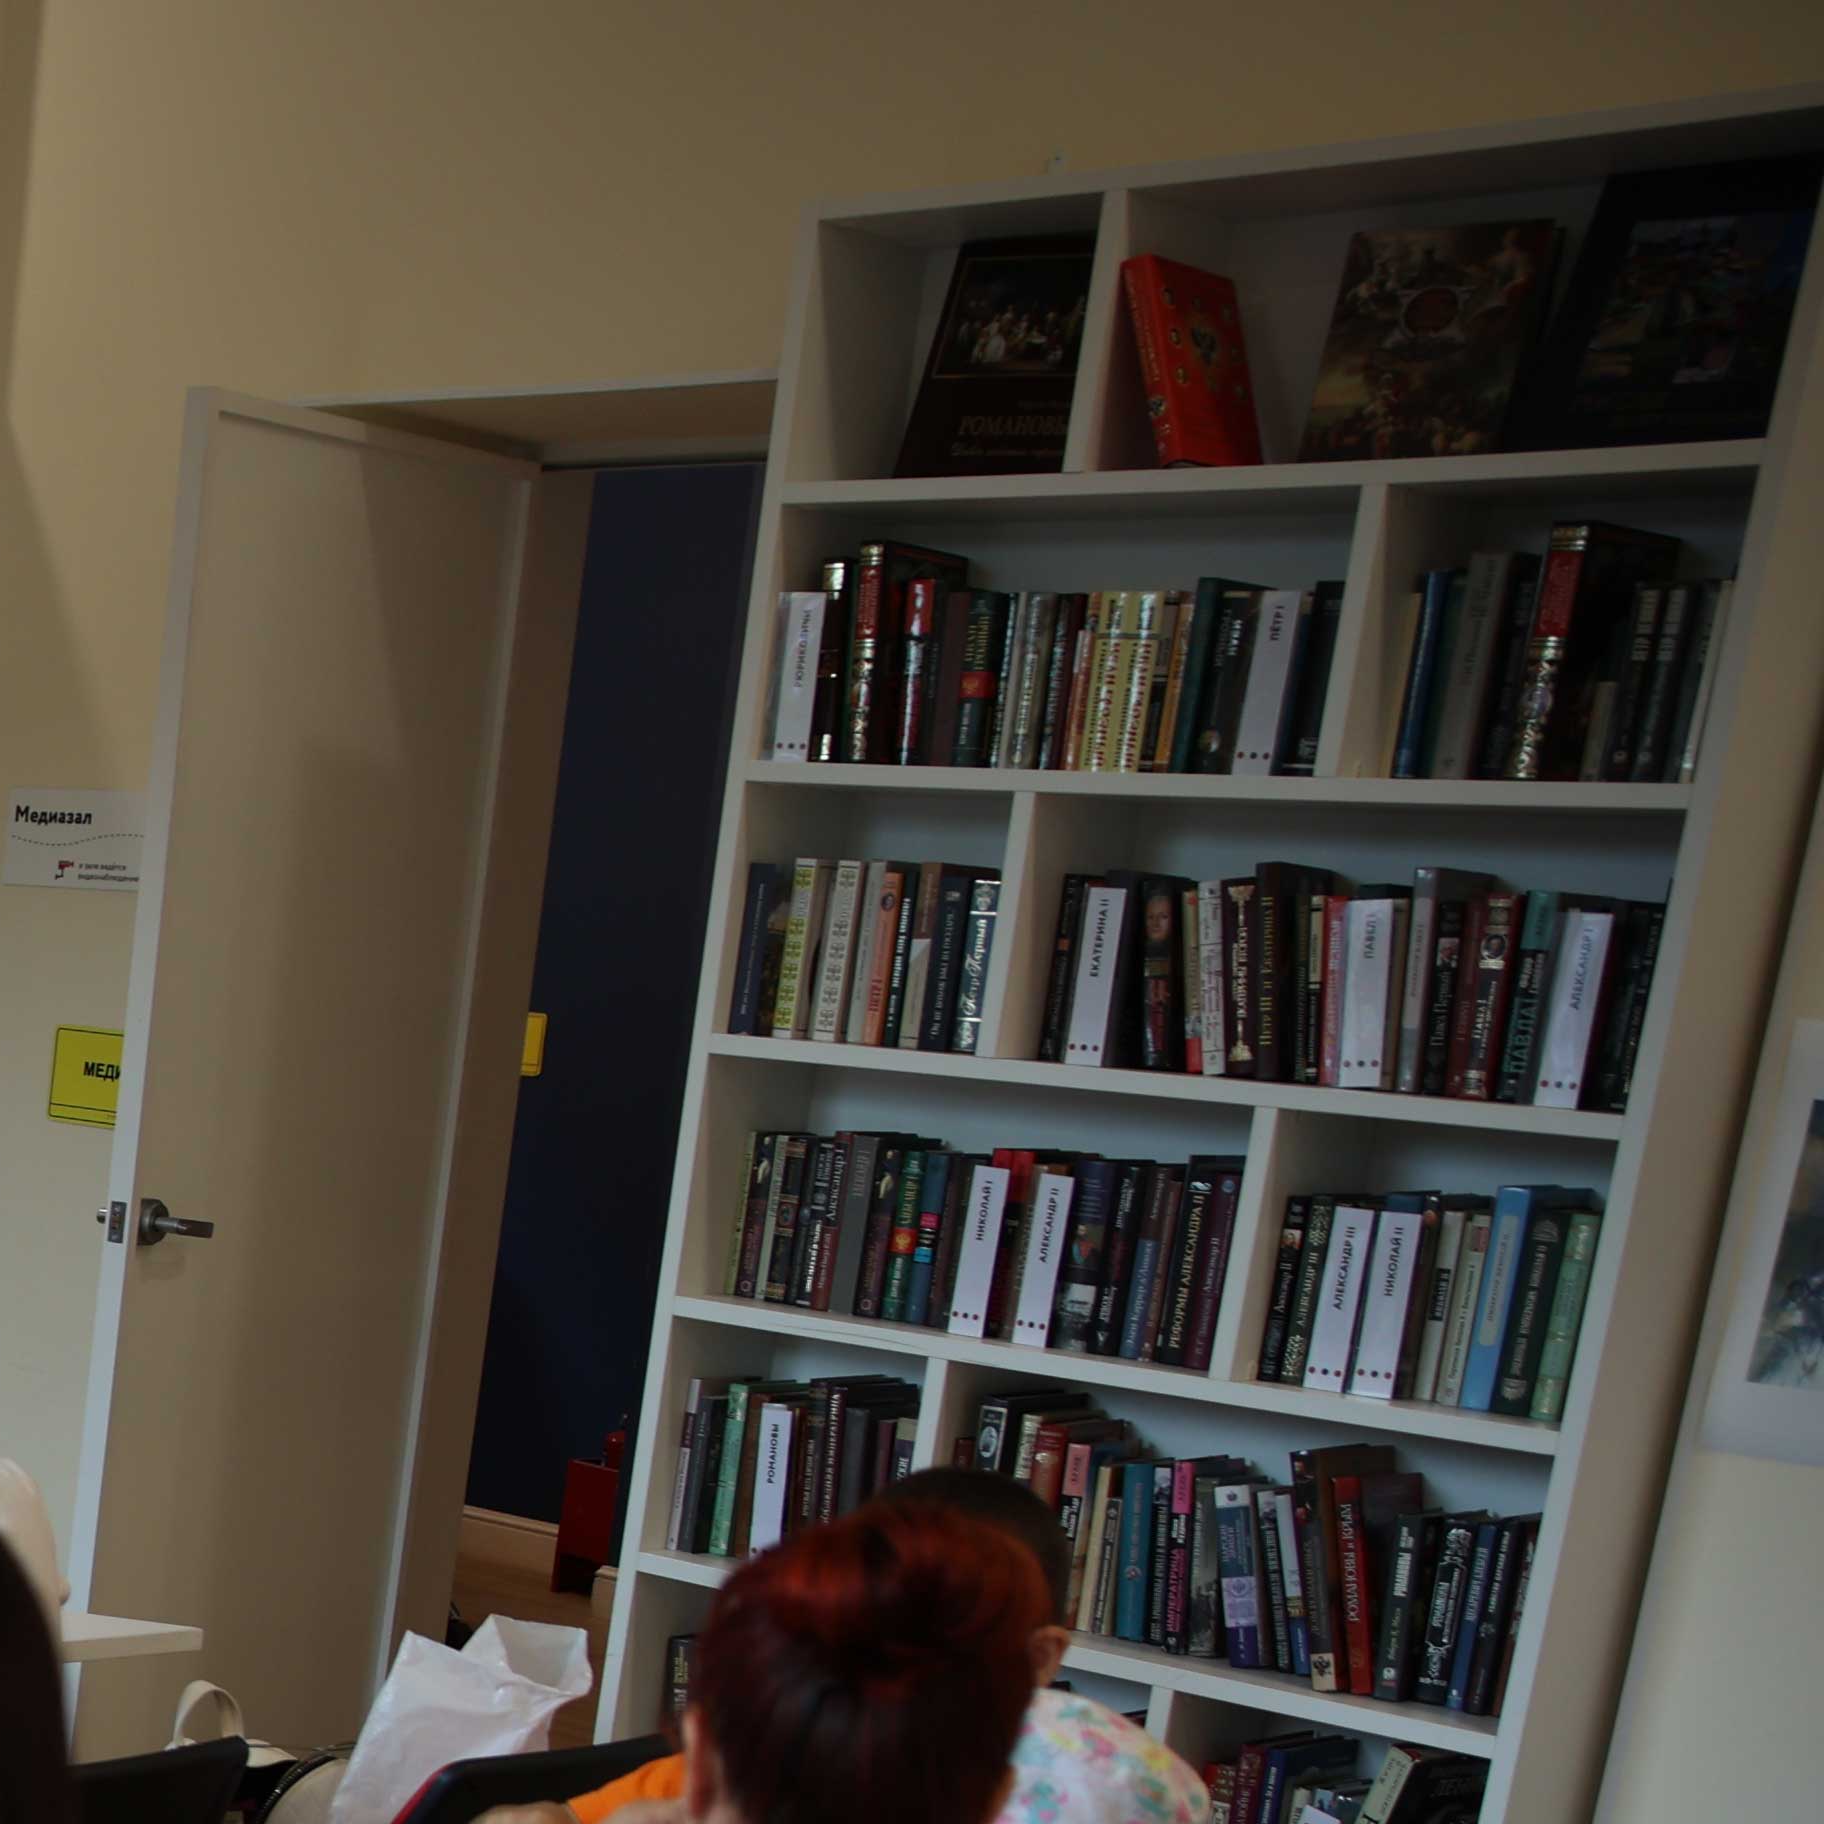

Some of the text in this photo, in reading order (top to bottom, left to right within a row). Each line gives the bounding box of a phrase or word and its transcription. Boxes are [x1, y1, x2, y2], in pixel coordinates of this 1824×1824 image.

[14, 803, 93, 825] Медиазал
[1089, 909, 1109, 978] ЕКАТЕРИНА
[1363, 920, 1378, 960] ПАВЕЛ
[1568, 935, 1593, 1010] АЛЕКСАНДР
[975, 1186, 993, 1241] НИКОЛАЙ
[1038, 1197, 1057, 1263] АЛЕКСАНДР
[1177, 1206, 1203, 1286] АЛЕКСАНДРА
[1332, 1240, 1354, 1311] АЛЕКСАНДР
[1383, 1236, 1403, 1297] НИКОЛАЙ
[1167, 1287, 1191, 1349] РЕФОРМЫ
[766, 1424, 780, 1485] РОМАНОВЫ
[1338, 1503, 1356, 1541] КРЫМ
[1343, 1551, 1362, 1622] РОМАНОВЫ
[1392, 1552, 1413, 1597] РОМАНОВЫ
